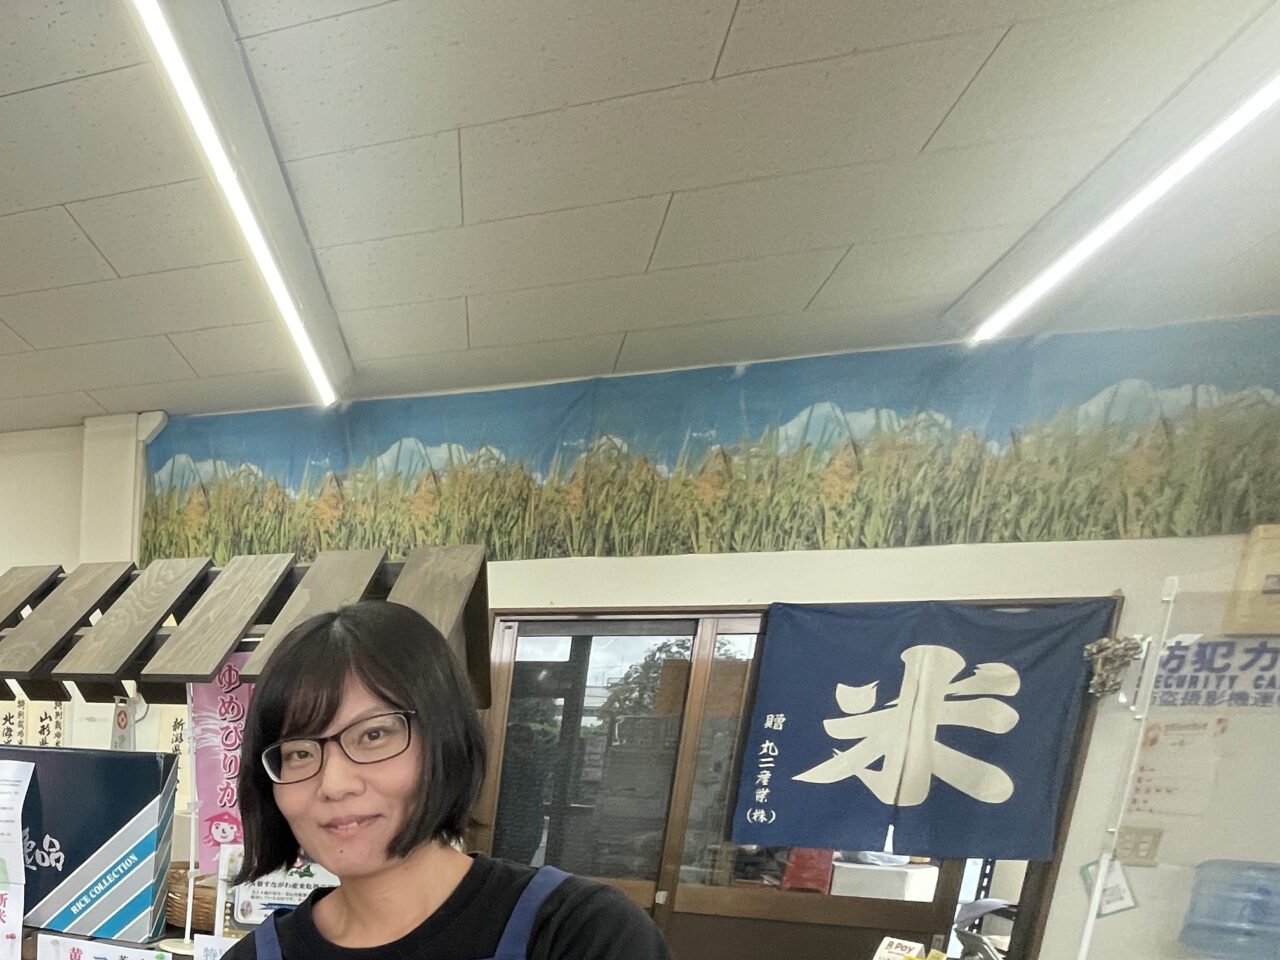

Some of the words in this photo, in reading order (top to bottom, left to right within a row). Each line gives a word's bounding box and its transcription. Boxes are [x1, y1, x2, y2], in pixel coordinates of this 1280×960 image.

[1152, 674, 1239, 689] ECURITY
[1253, 674, 1280, 689] CA
[764, 713, 786, 730] 贈
[791, 645, 1021, 806] 米
[70, 894, 92, 915] RICE
[89, 853, 139, 900] COLLECTION
